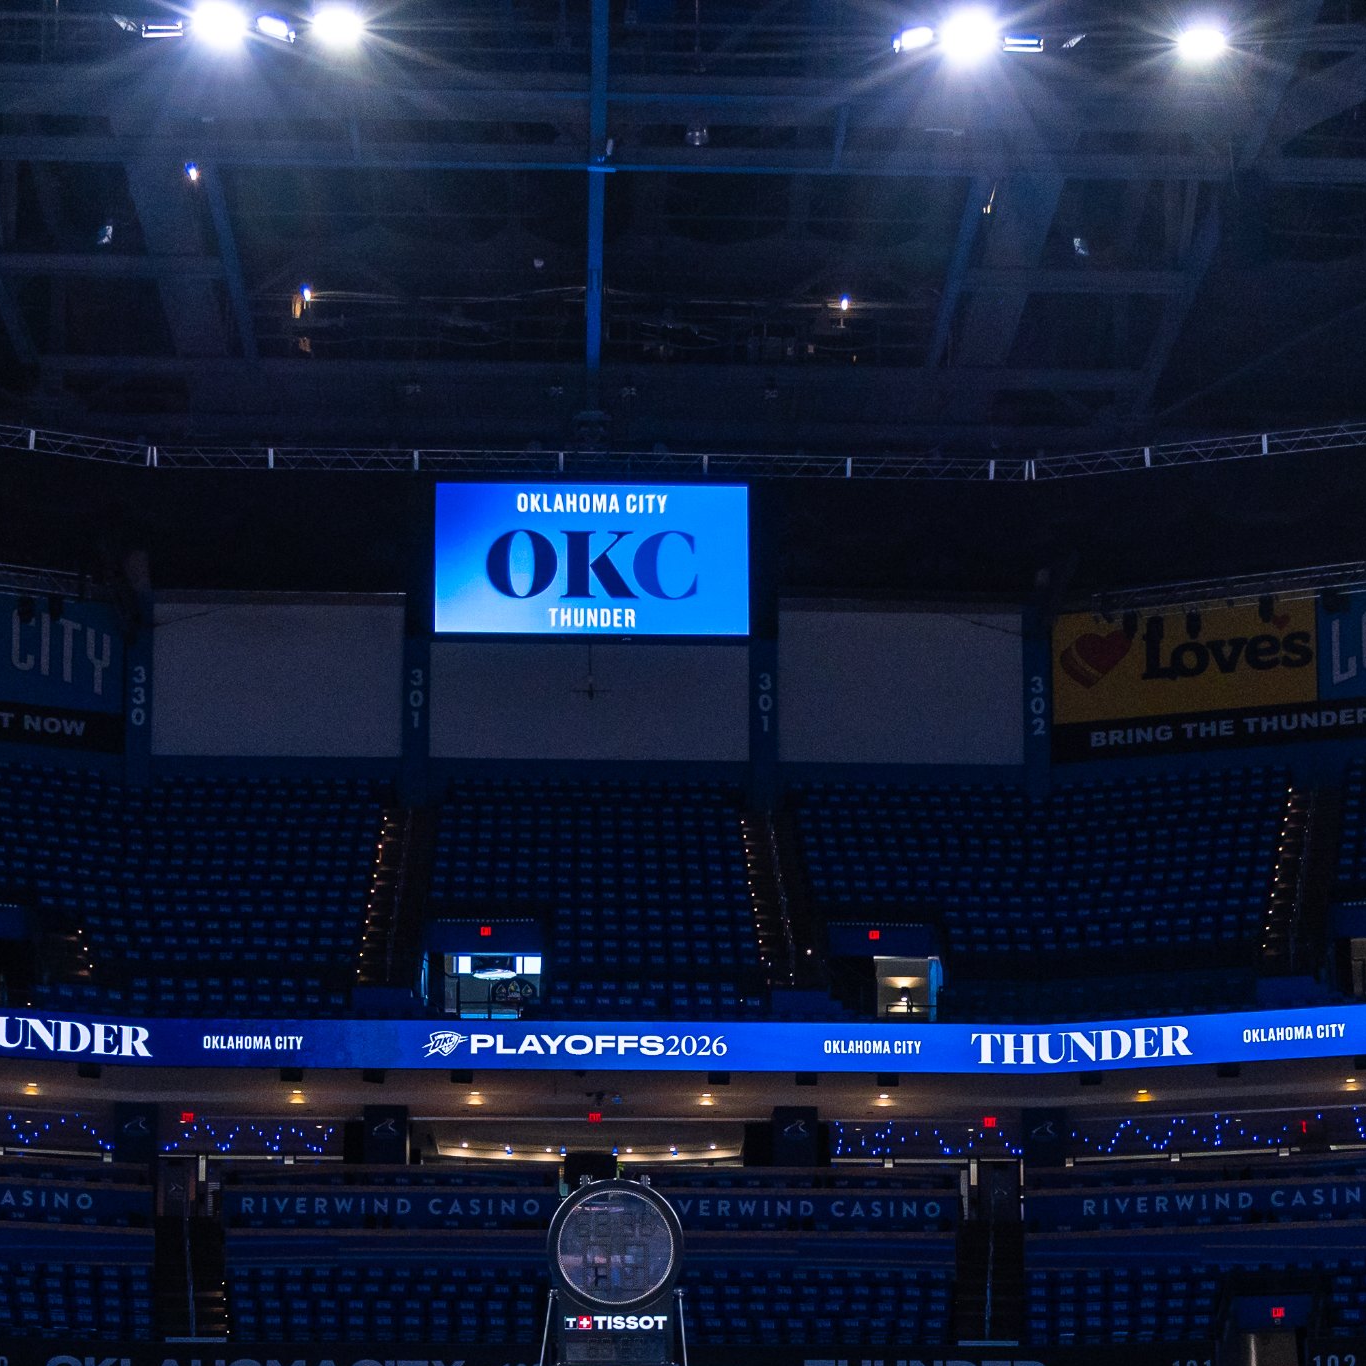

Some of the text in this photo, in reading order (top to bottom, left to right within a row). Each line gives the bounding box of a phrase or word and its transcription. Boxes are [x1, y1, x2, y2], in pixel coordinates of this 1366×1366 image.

[517, 493, 667, 513] OKLAHOMA CITY
[486, 529, 697, 600] OKC
[548, 607, 635, 628] THUNDER
[12, 609, 110, 694] CITY
[131, 666, 146, 725] 330
[410, 669, 423, 728] 301
[759, 673, 772, 731] 301
[1031, 676, 1045, 735] 302
[24, 716, 86, 736] NOW
[1090, 722, 1172, 747] BRING
[1182, 720, 1234, 738] THE
[203, 1036, 304, 1050] OKLAHOMA CITY
[971, 1026, 1192, 1064] THUNDER
[1243, 1024, 1345, 1043] OKLAHOMA CITY
[824, 1040, 922, 1055] OKLAHOMA CITY
[242, 1197, 539, 1215] RIVERWIND CASINO
[831, 1201, 940, 1217] CASINO
[1082, 1190, 1253, 1216] RIVERWIND
[594, 1316, 667, 1329] TISSOT
